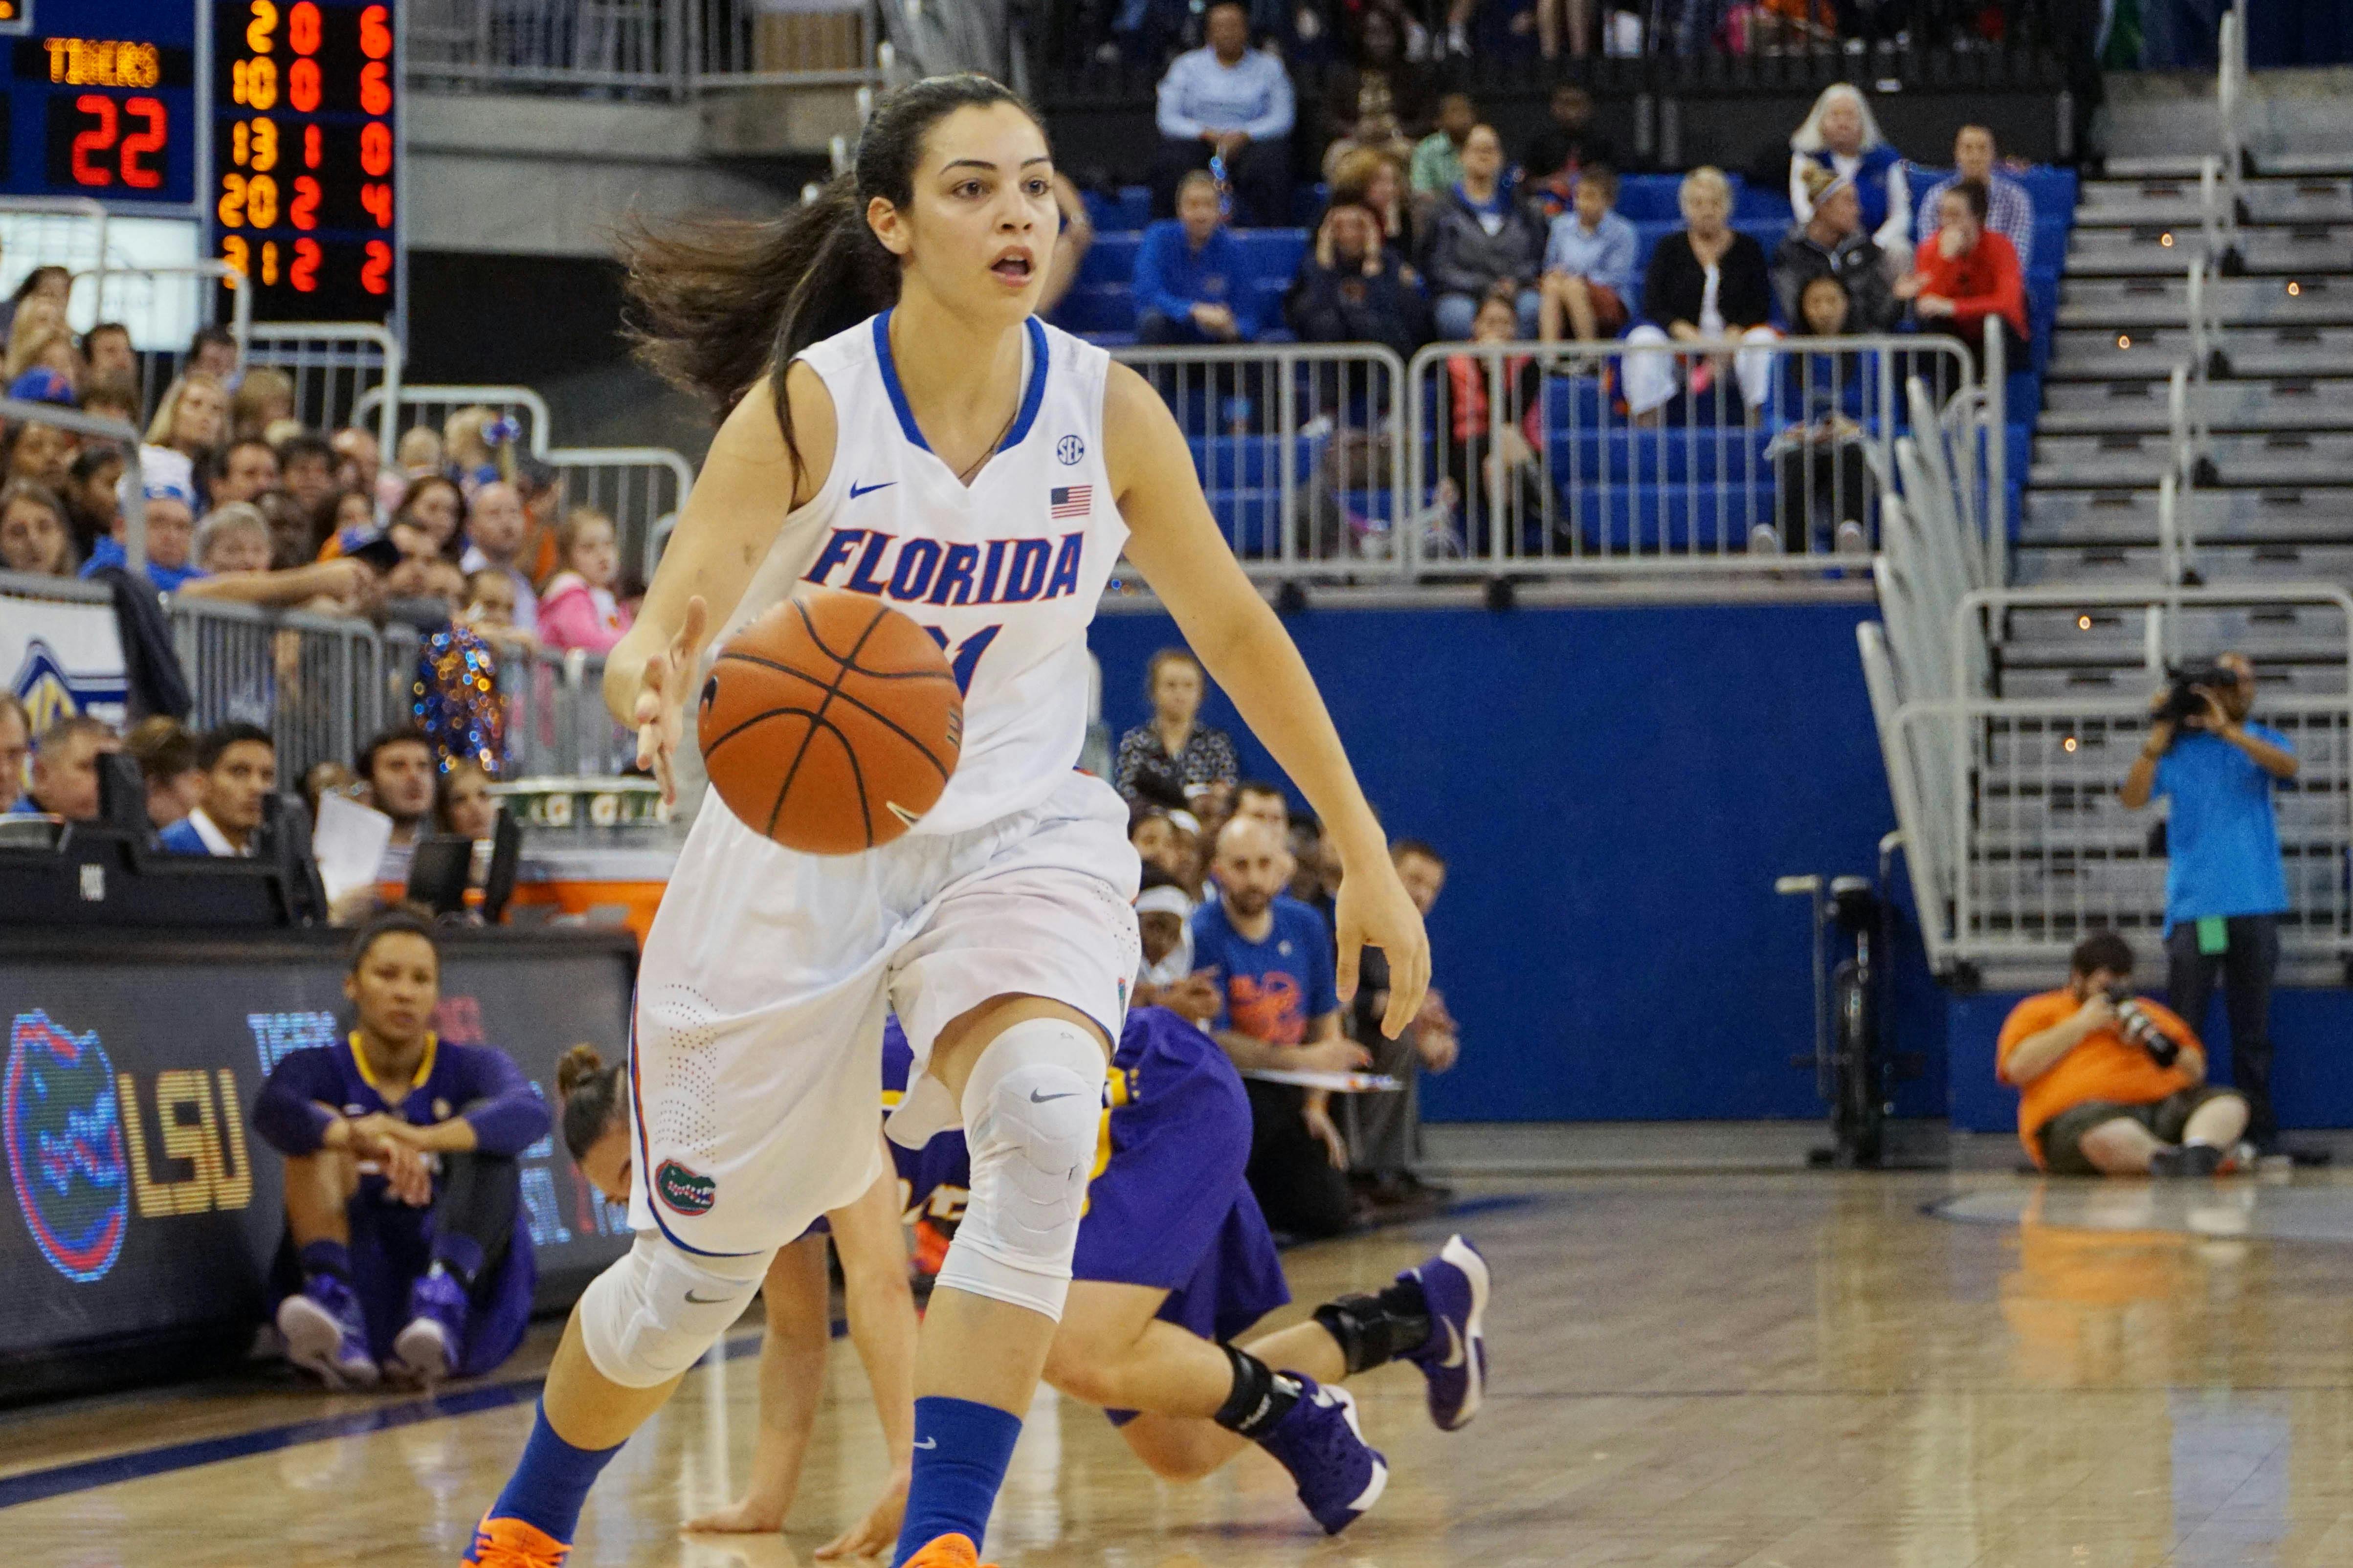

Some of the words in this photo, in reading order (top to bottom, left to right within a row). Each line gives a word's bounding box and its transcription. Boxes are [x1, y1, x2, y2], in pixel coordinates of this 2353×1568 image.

[247, 0, 277, 53] 2
[289, 1, 321, 55] 0
[360, 5, 391, 59] 6
[233, 56, 277, 110] 10
[289, 58, 321, 112] 0
[361, 61, 391, 115] 6
[72, 95, 167, 188] 22
[233, 117, 277, 171] 13
[305, 124, 321, 169] 1
[361, 122, 391, 176] 0
[219, 174, 277, 228] 20
[290, 176, 321, 230] 2
[361, 183, 391, 228] 4
[290, 237, 321, 292] 2
[361, 240, 391, 294] 2
[1057, 435, 1085, 465] SEC
[799, 526, 1085, 607] FLORIDA
[117, 1068, 252, 1218] LSU
